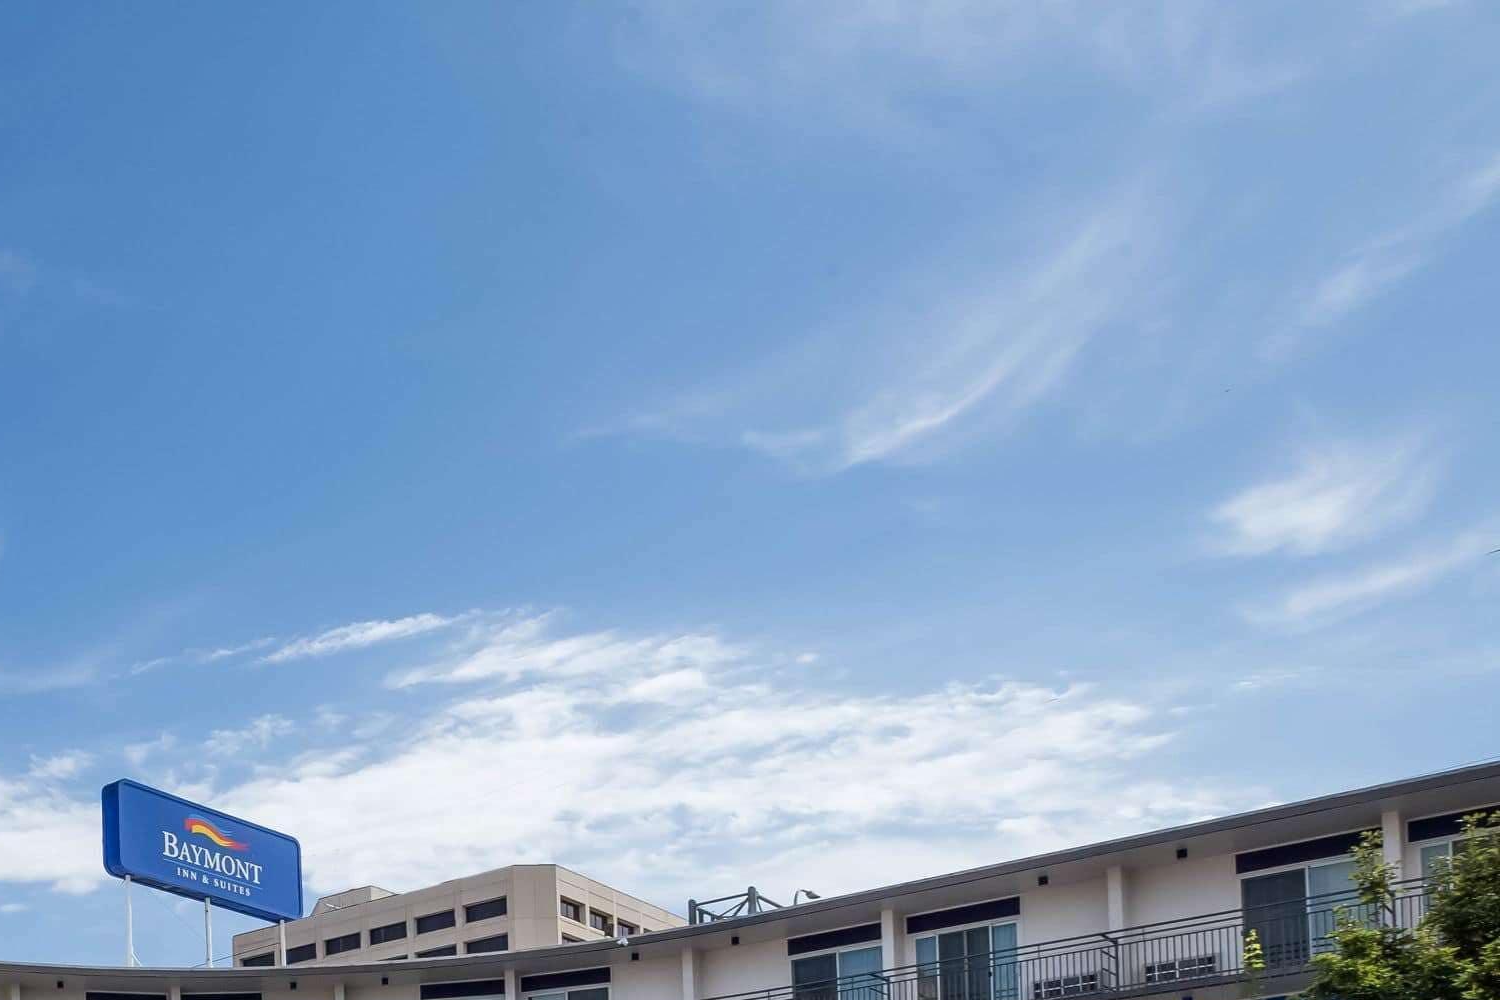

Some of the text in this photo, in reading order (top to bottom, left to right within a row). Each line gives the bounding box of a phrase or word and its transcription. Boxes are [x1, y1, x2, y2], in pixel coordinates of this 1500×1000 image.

[162, 831, 262, 884] BAYMONT
[177, 867, 250, 896] INN & SUITES
